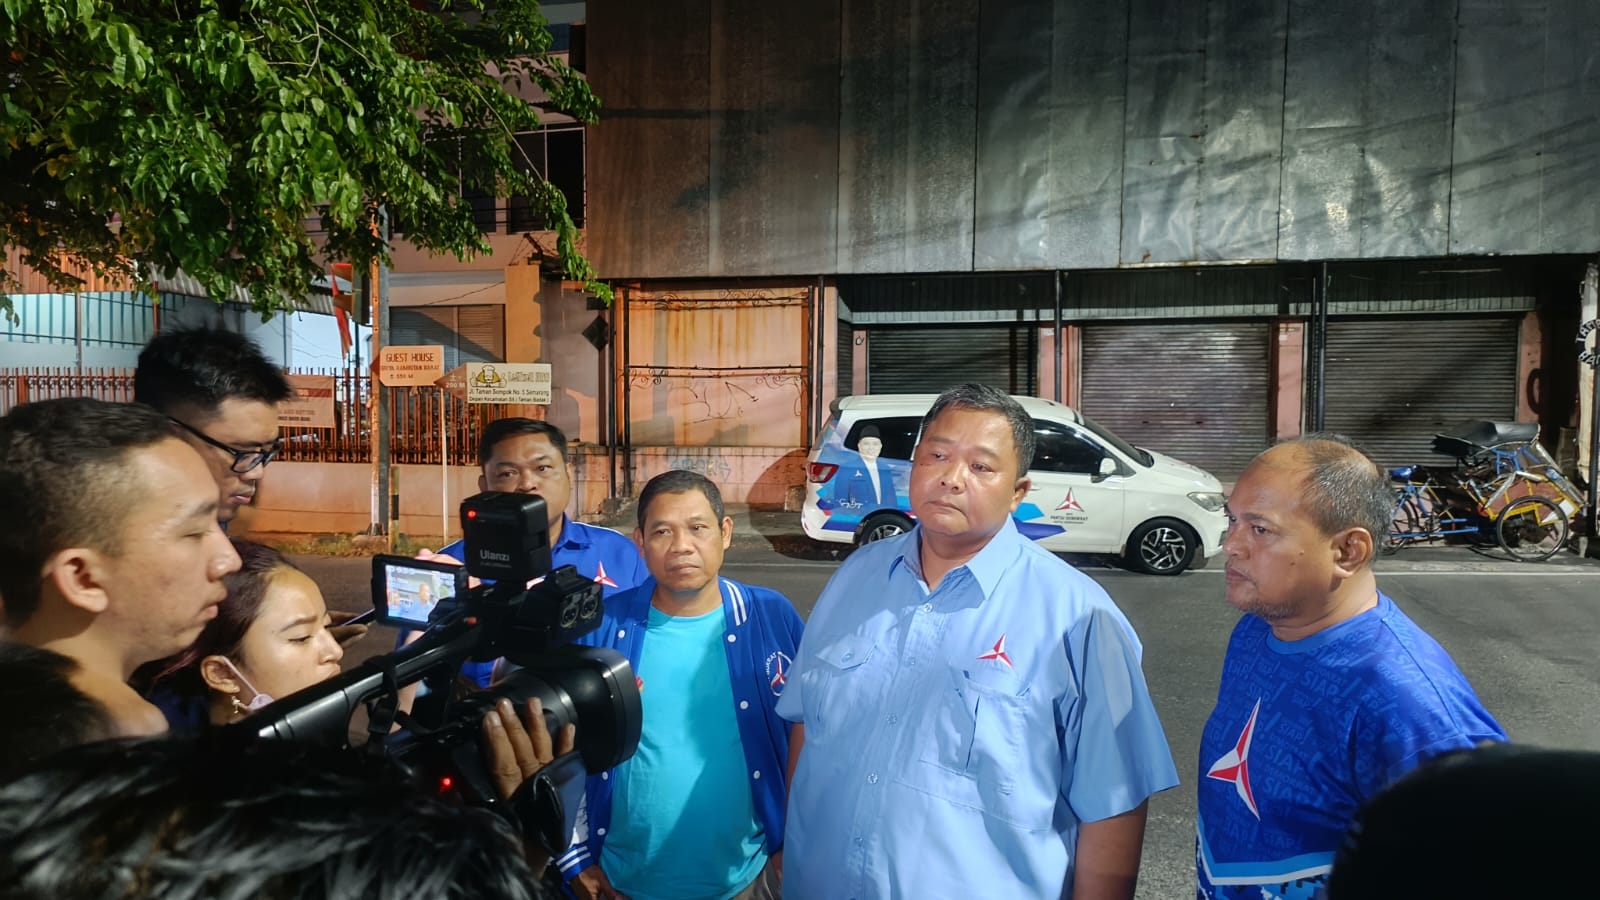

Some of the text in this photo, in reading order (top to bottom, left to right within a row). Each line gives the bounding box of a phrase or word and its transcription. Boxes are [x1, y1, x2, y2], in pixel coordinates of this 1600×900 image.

[386, 352, 434, 362] GUEST HOUSE
[480, 548, 510, 562] Ulanzi
[1300, 670, 1362, 705] SIAP!
